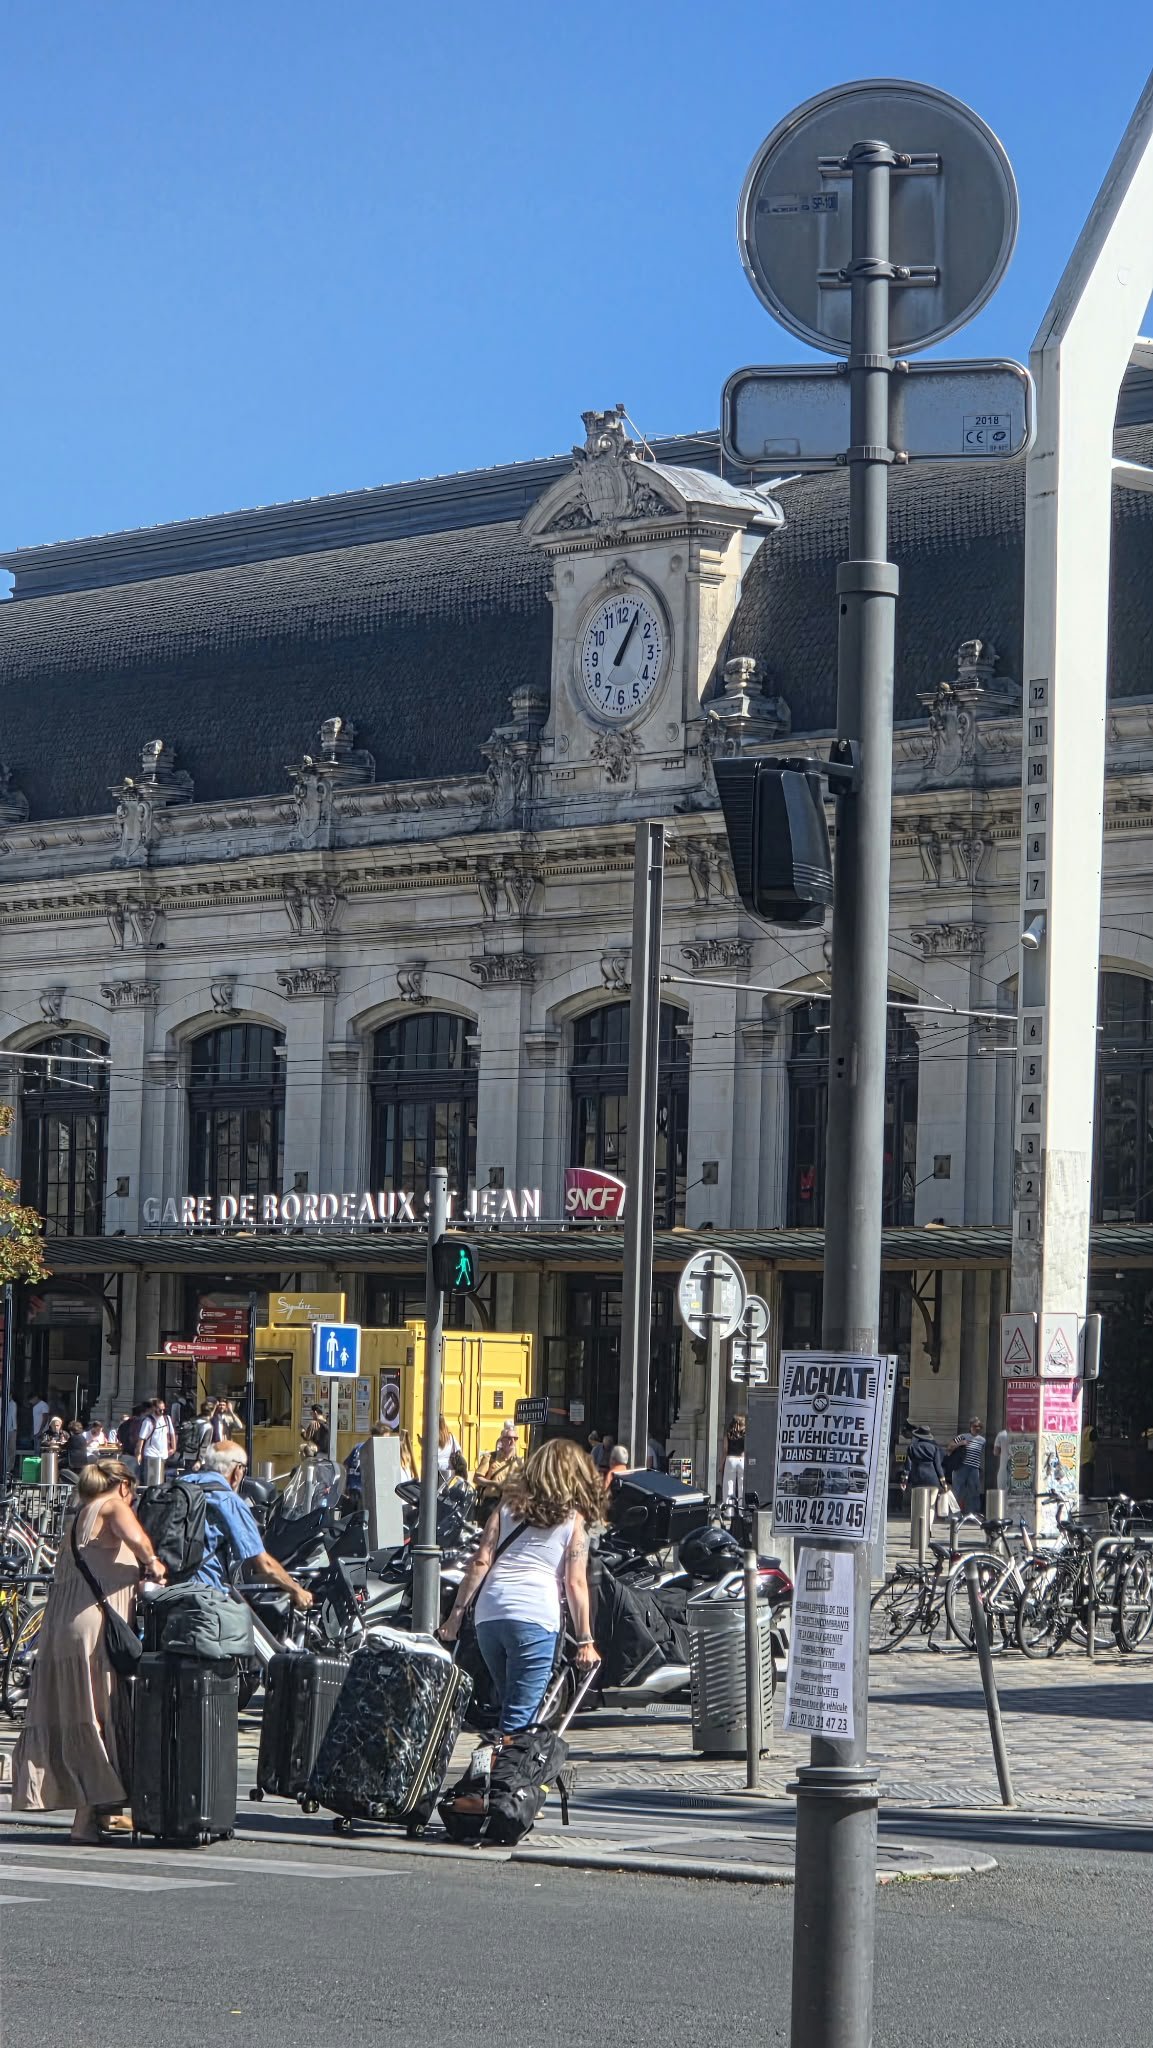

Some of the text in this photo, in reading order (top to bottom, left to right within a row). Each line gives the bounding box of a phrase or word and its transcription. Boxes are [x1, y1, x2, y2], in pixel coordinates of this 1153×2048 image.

[975, 416, 999, 425] 2018
[966, 431, 984, 443] CE
[605, 613, 614, 629] 11
[617, 607, 629, 624] 12
[643, 623, 651, 638] 2
[594, 631, 604, 646] 10
[592, 652, 599, 667] 9
[647, 645, 654, 660] 3
[642, 665, 648, 680] 4
[595, 673, 601, 687] 8
[605, 686, 611, 701] 7
[618, 690, 624, 705] 6
[632, 684, 639, 698] 5
[1033, 687, 1044, 700] 12
[1034, 725, 1043, 738] 11
[1032, 763, 1043, 776] 10
[1034, 802, 1040, 815] 9
[1033, 841, 1040, 853] 8
[1033, 879, 1039, 892] 7
[1030, 1025, 1036, 1037] 6
[1029, 1064, 1036, 1076] 5
[1028, 1102, 1035, 1115] 4
[1027, 1141, 1034, 1154] 3
[1026, 1181, 1033, 1193] 2
[142, 1196, 212, 1222] GARE
[219, 1194, 255, 1222] DE
[263, 1191, 415, 1222] BORDEAUX
[464, 1188, 541, 1218] JEAN
[565, 1187, 617, 1211] SNCF
[1026, 1219, 1031, 1232] 1
[790, 1365, 875, 1400] ACHAT
[786, 1414, 865, 1431] TOUT TYPE
[782, 1428, 869, 1447] DE VÉHICULE
[785, 1448, 860, 1464] DANS L'ÉTAT
[795, 1500, 807, 1524] 32
[810, 1501, 824, 1525] 42
[826, 1502, 843, 1526] 29
[846, 1503, 864, 1528] 45
[836, 1606, 849, 1615] TOUS
[826, 1717, 836, 1729] 47
[837, 1718, 848, 1731] 23
